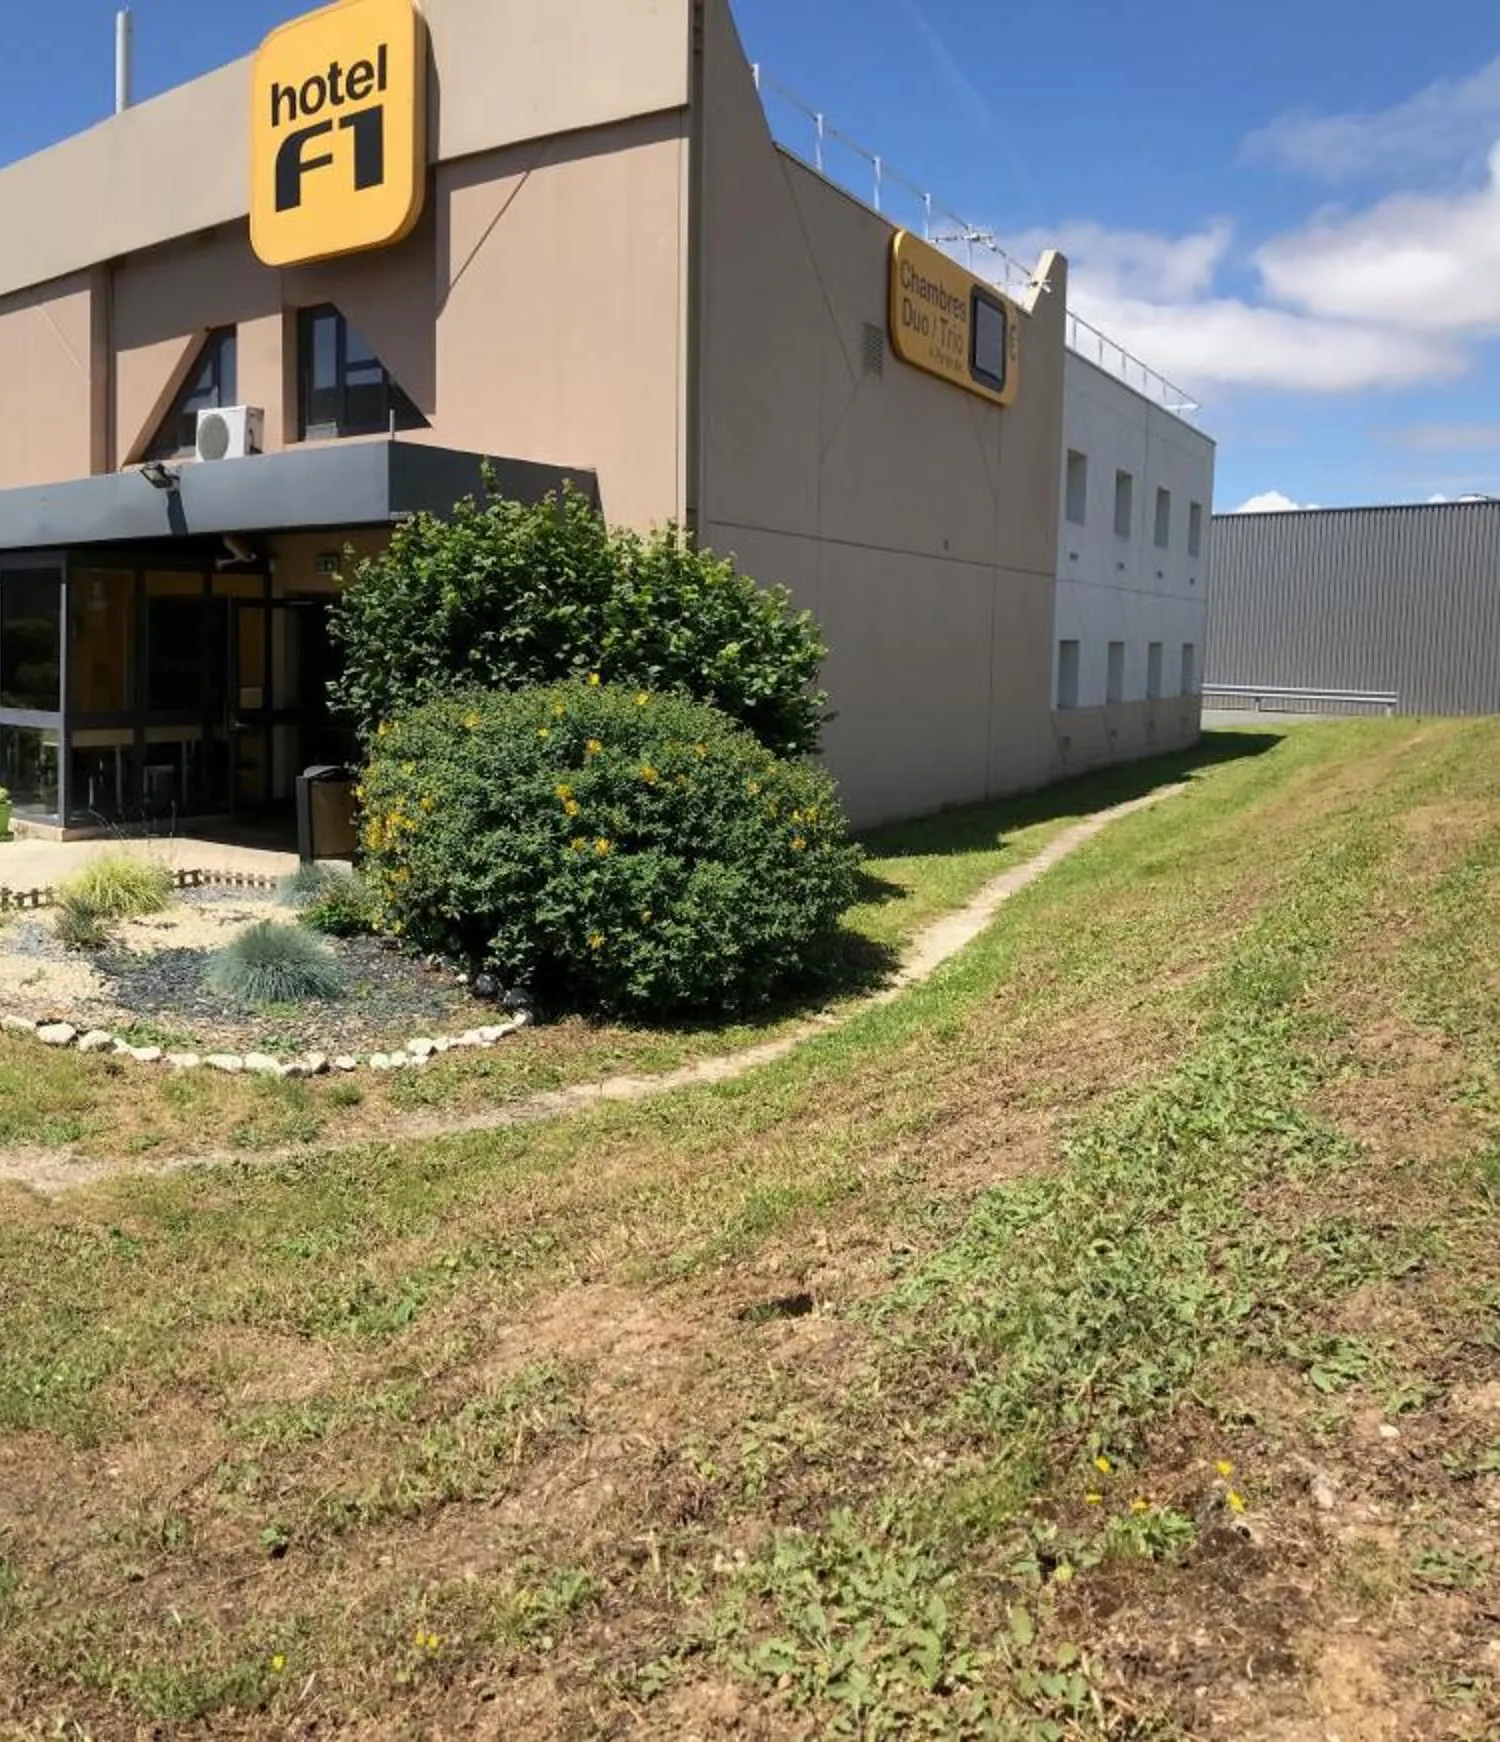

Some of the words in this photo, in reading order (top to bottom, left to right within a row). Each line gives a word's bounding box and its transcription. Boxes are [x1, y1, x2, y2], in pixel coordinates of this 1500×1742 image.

[271, 43, 388, 128] hotel
[275, 103, 384, 213] F1
[900, 260, 966, 323] Chambres
[903, 297, 929, 336] Duo
[940, 317, 964, 355] Trio
